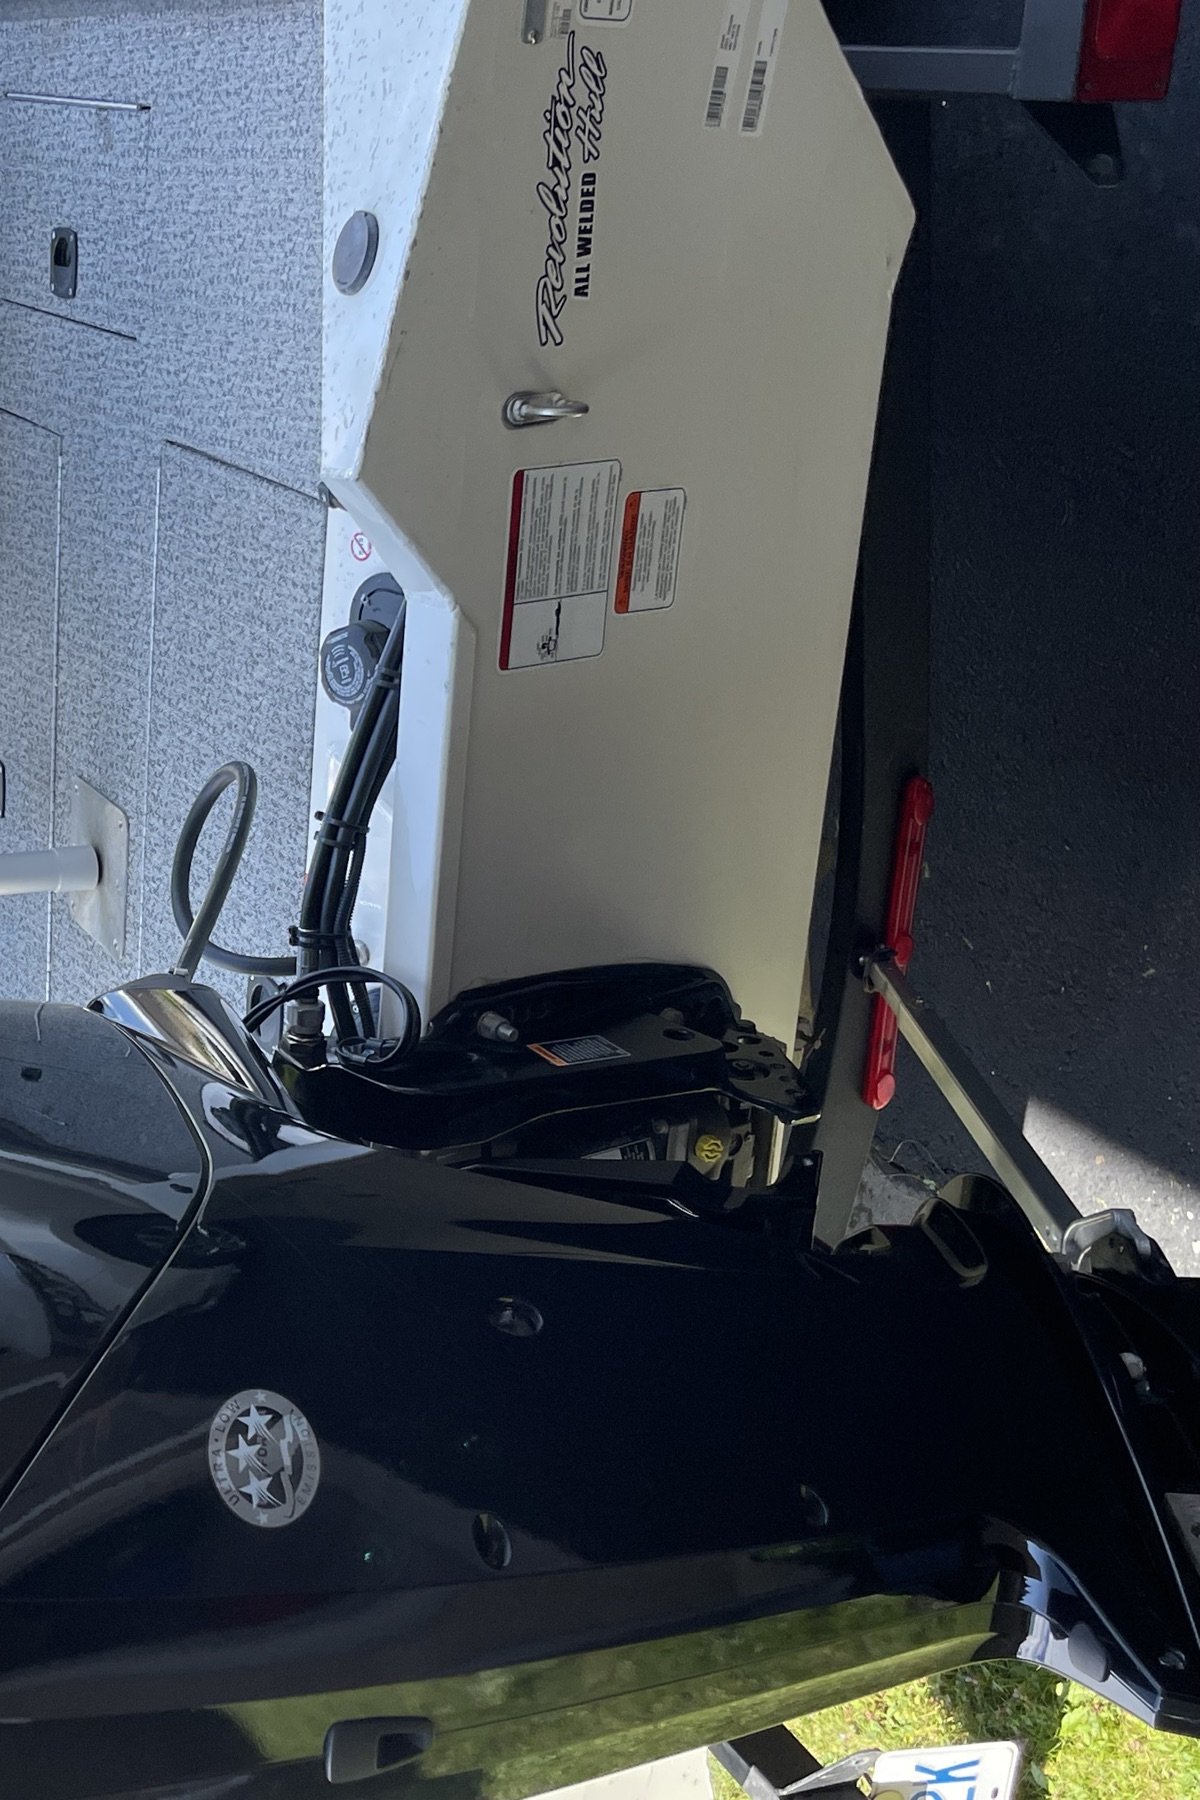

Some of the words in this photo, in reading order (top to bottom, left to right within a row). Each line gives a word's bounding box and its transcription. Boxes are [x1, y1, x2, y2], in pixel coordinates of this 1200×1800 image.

[575, 46, 608, 163] Hull
[536, 31, 576, 348] Revolution
[575, 172, 596, 258] WELDED
[573, 262, 591, 298] ALL
[213, 1399, 241, 1432] LOW
[211, 1448, 240, 1506] ULTRA
[294, 1414, 318, 1506] EMISSION
